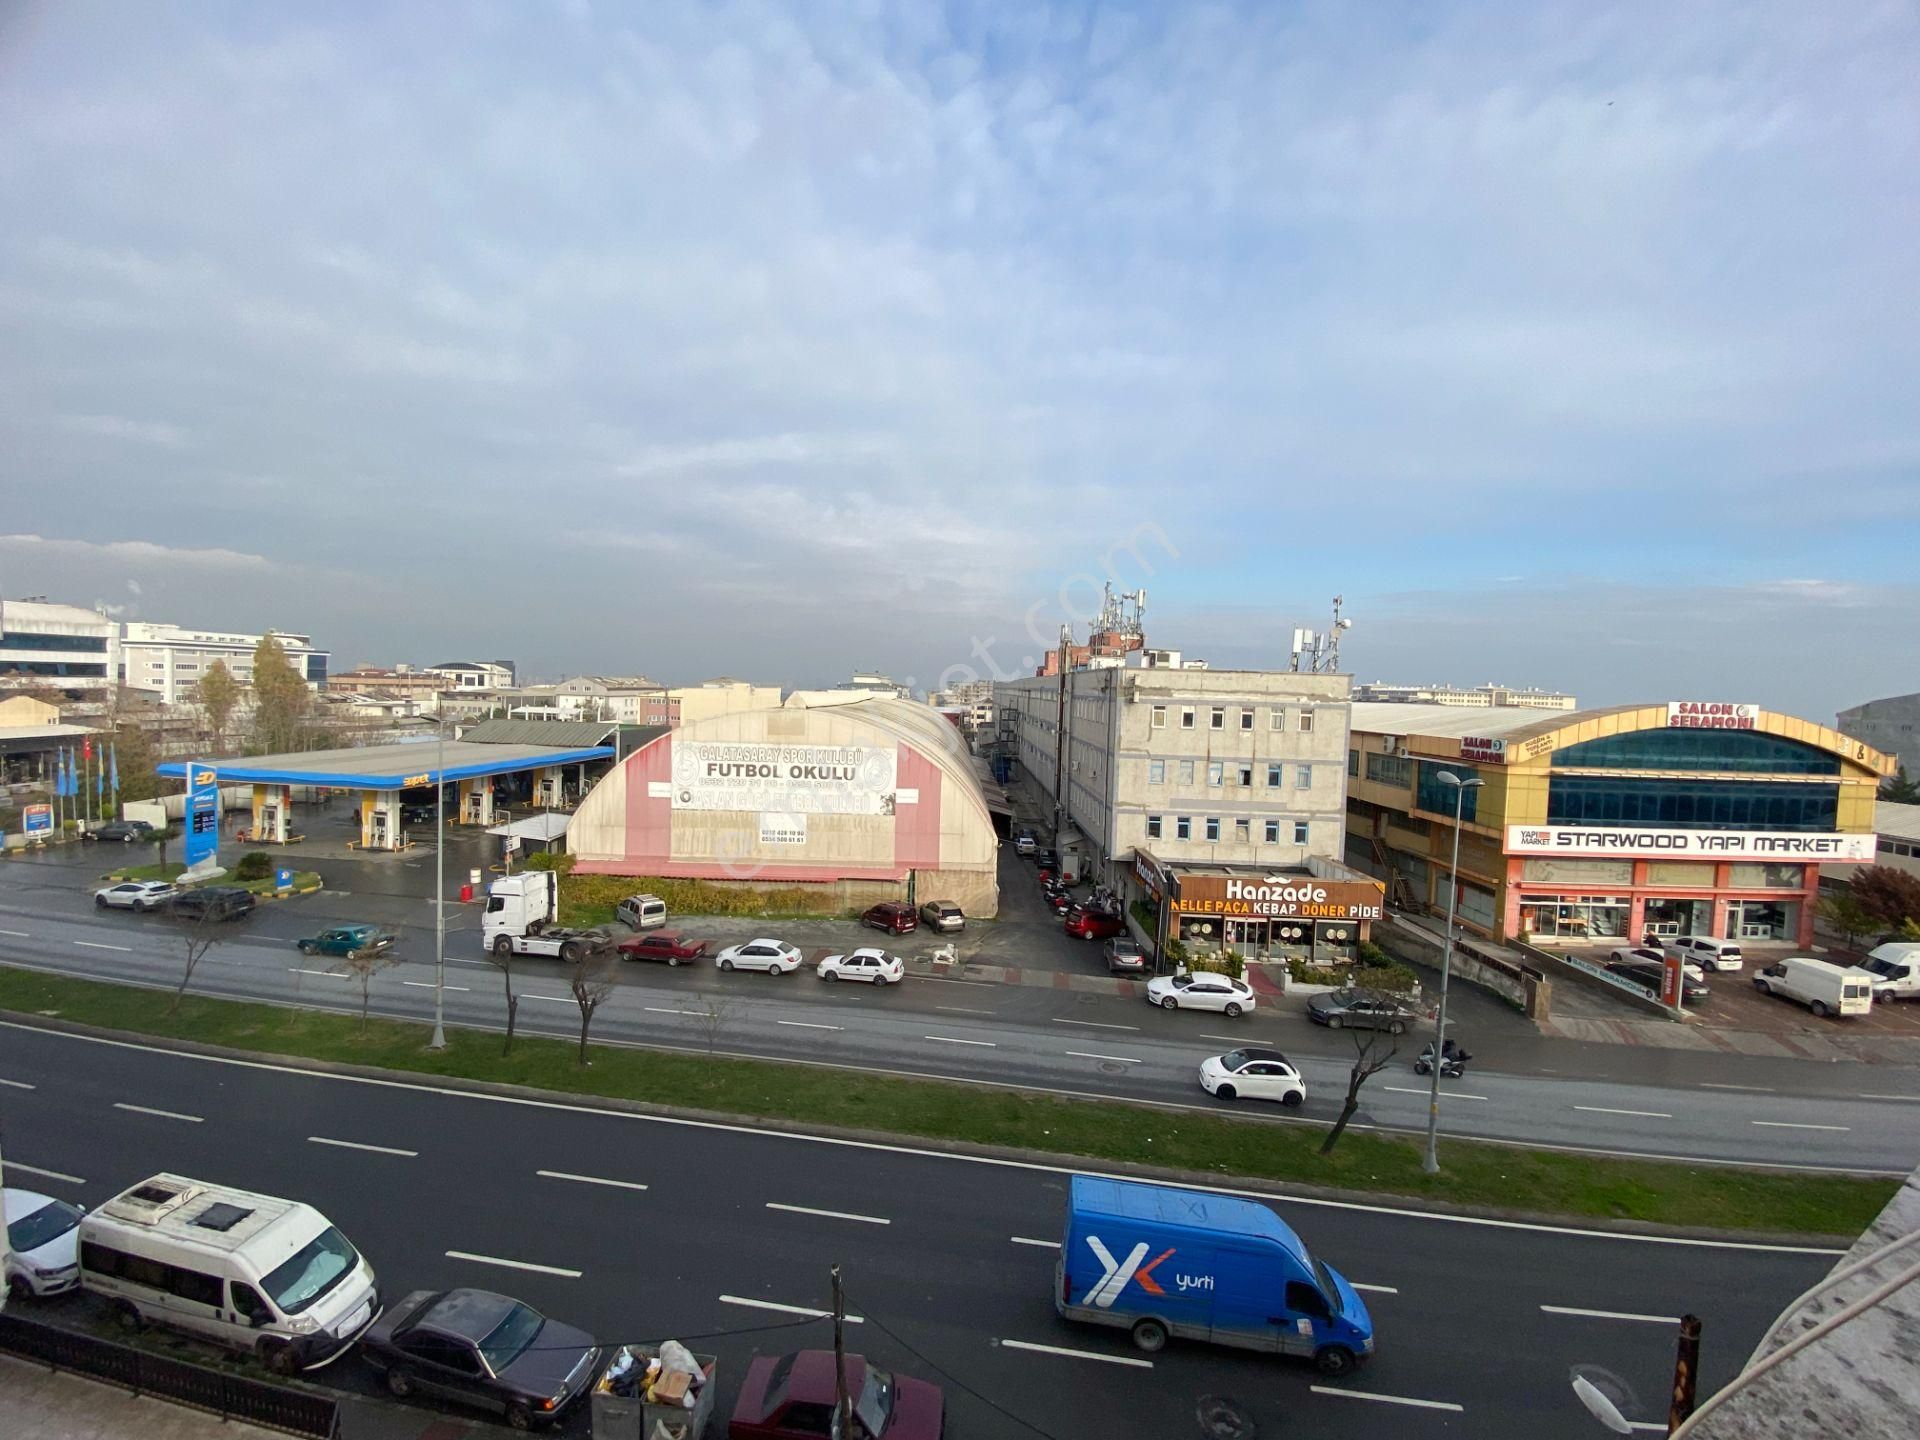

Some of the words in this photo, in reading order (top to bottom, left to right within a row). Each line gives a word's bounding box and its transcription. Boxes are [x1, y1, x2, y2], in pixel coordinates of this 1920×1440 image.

[1679, 703, 1733, 716] SALON
[700, 746, 781, 762] GALATASARAY
[784, 748, 815, 764] SPOR
[816, 748, 864, 766] KULÜBÜ
[1856, 745, 1864, 760] &
[707, 763, 783, 779] FUTBOL
[789, 765, 856, 781] OKULU
[695, 791, 734, 808] ASLAN
[1521, 838, 1551, 846] MARKET
[1556, 832, 1688, 849] STARWOOD
[1696, 835, 1745, 850] YAPI
[1753, 837, 1843, 853] MARKET
[1226, 879, 1327, 903] Hanzade
[1215, 901, 1249, 914] PAÇA
[1253, 902, 1297, 915] KEBAP
[1301, 902, 1346, 916] DÖNER
[1349, 903, 1380, 918] PİDE
[1176, 1273, 1214, 1292] yurti
